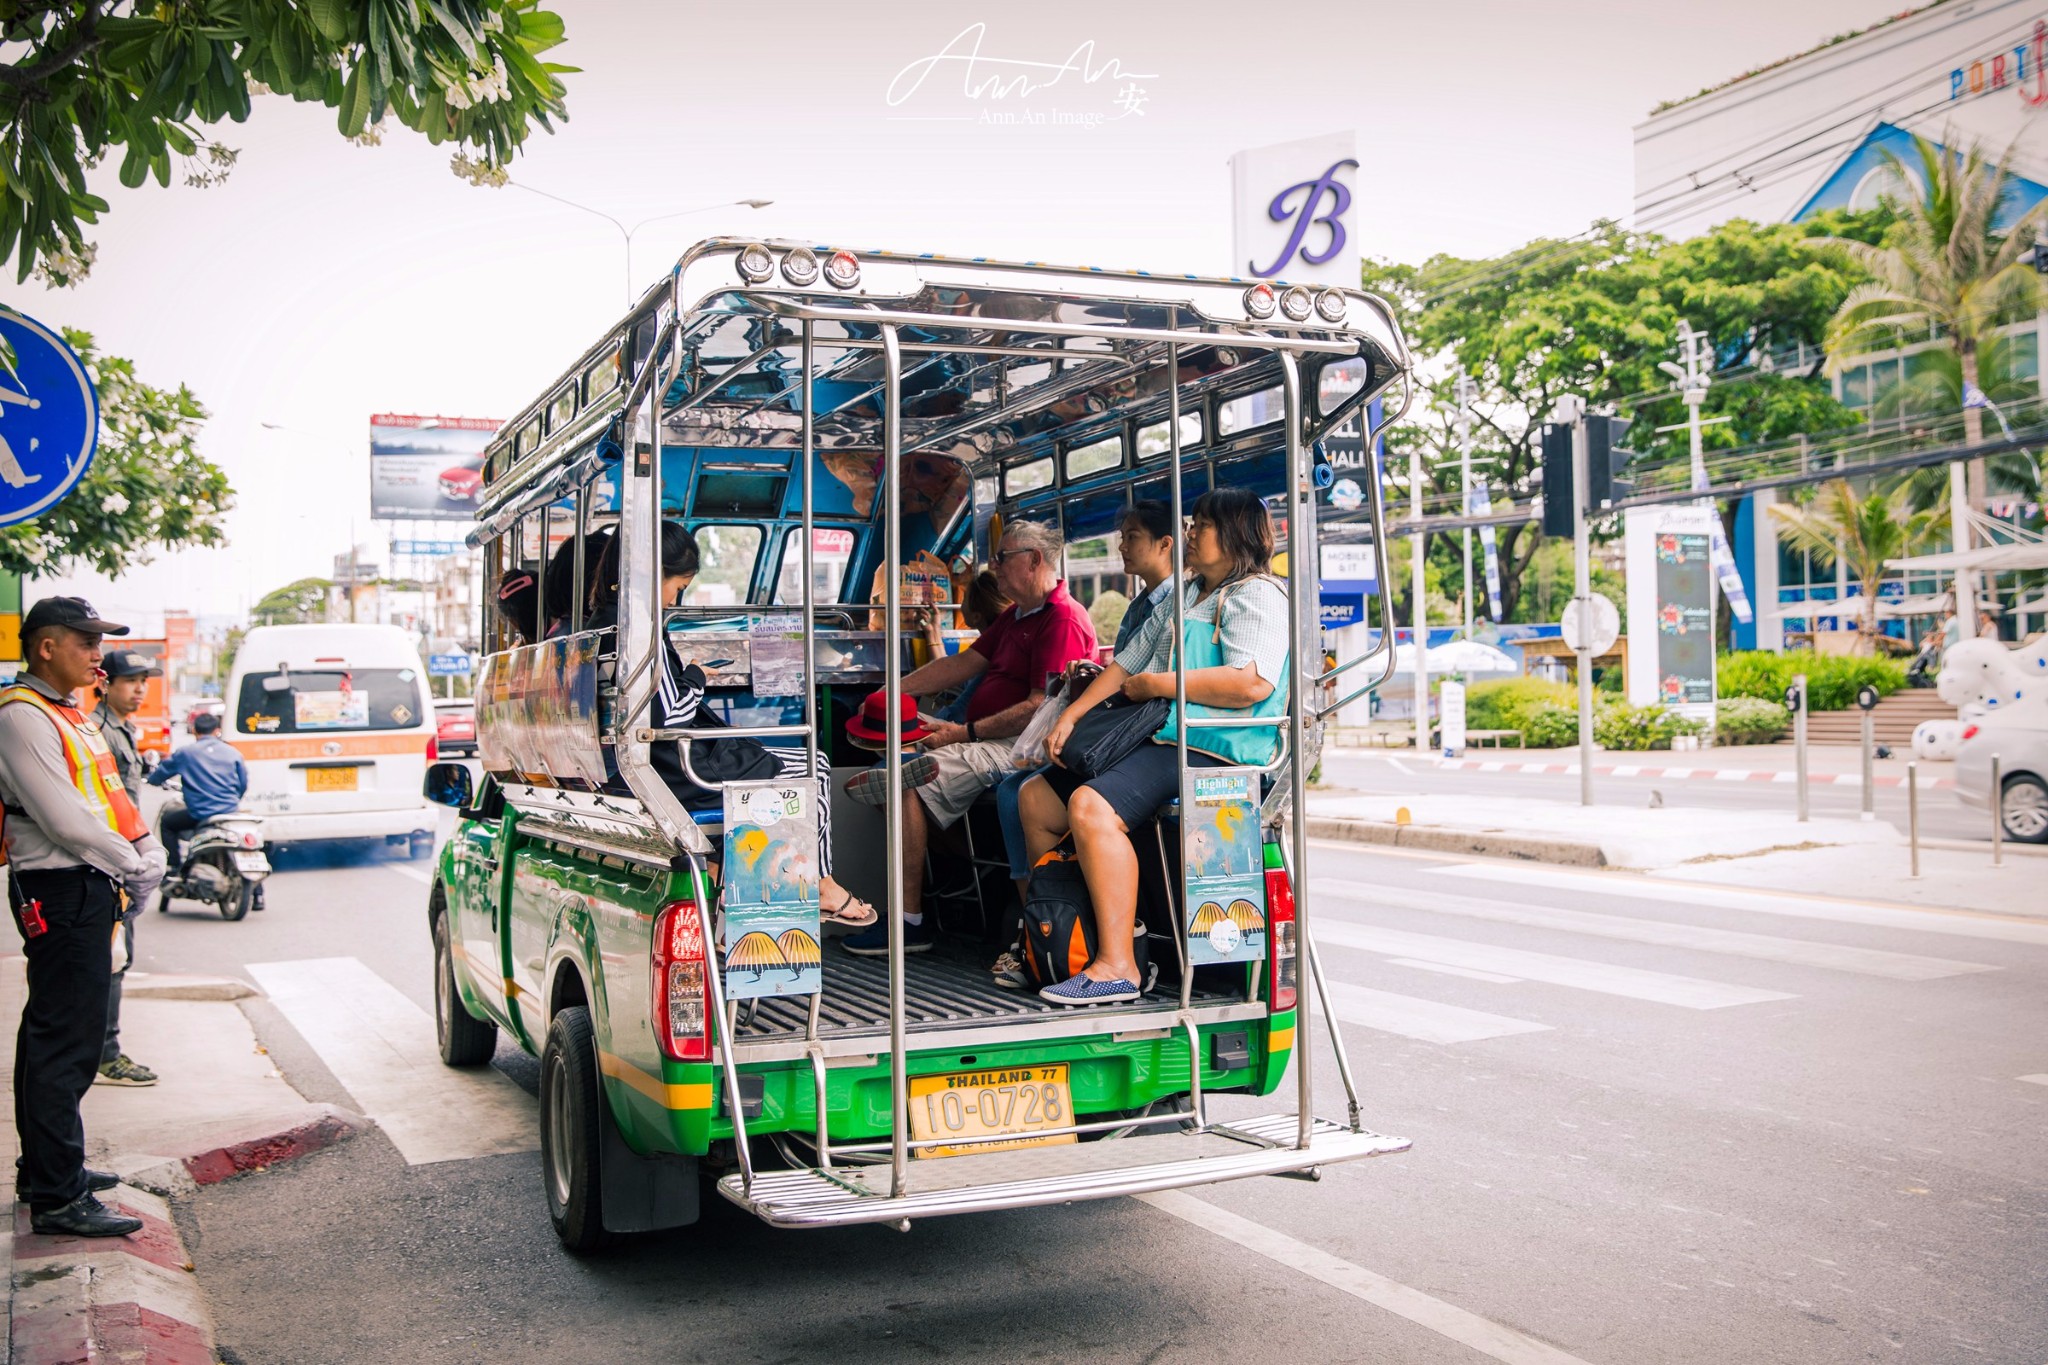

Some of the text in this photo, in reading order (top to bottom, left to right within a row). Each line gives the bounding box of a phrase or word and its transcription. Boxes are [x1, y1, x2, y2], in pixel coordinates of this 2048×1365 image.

[1249, 159, 1360, 278] B
[1327, 552, 1367, 561] MOBILE
[1348, 563, 1358, 573] IT
[1198, 777, 1244, 791] Highlight
[946, 1069, 1057, 1088] THAILAND 77
[926, 1083, 1062, 1133] 10-0728
